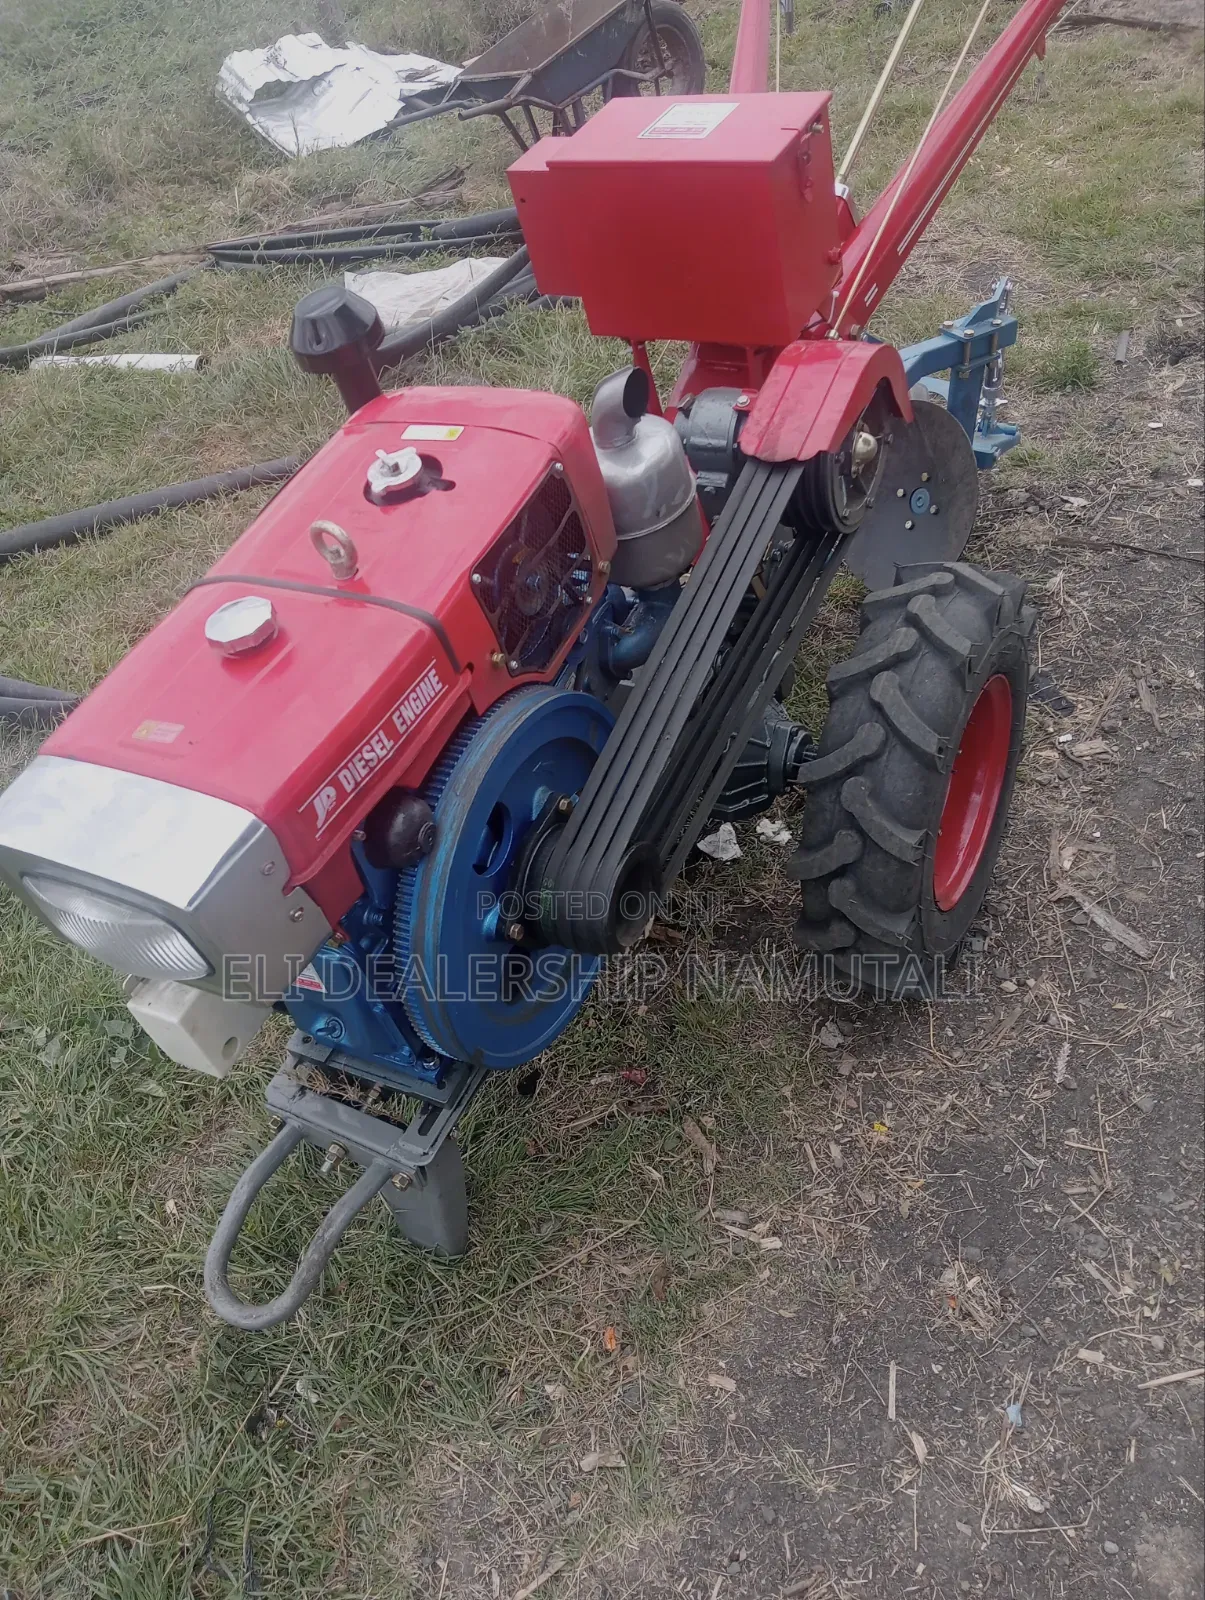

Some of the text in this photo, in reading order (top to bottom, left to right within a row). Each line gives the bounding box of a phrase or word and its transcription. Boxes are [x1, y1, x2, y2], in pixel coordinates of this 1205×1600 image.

[313, 668, 443, 829] JP DIESEL ENGINE
